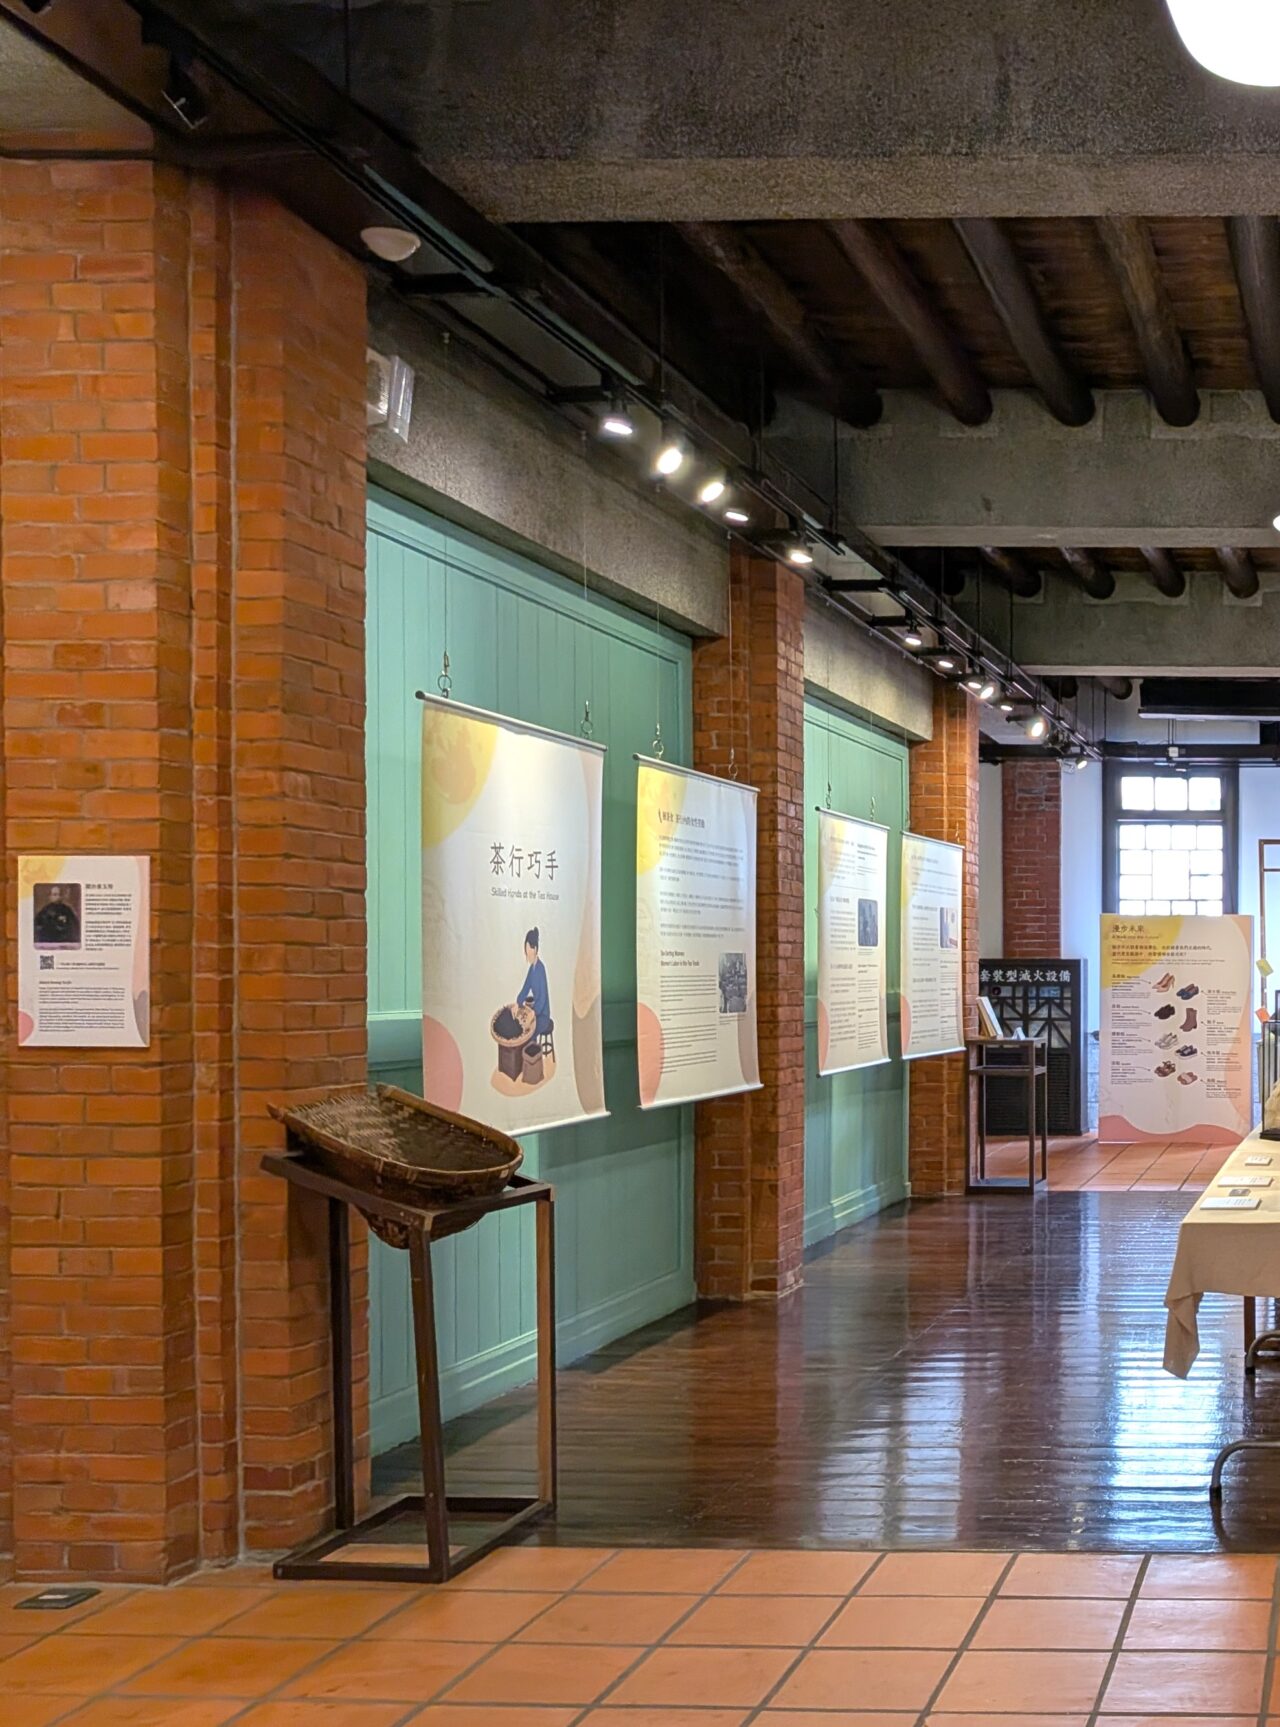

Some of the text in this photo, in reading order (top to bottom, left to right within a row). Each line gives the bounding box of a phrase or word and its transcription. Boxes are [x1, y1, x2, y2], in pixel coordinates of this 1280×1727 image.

[490, 842, 559, 881] 茶行巧手
[490, 886, 507, 897] Skilled
[980, 968, 1072, 983] 套裝型滅火設備
